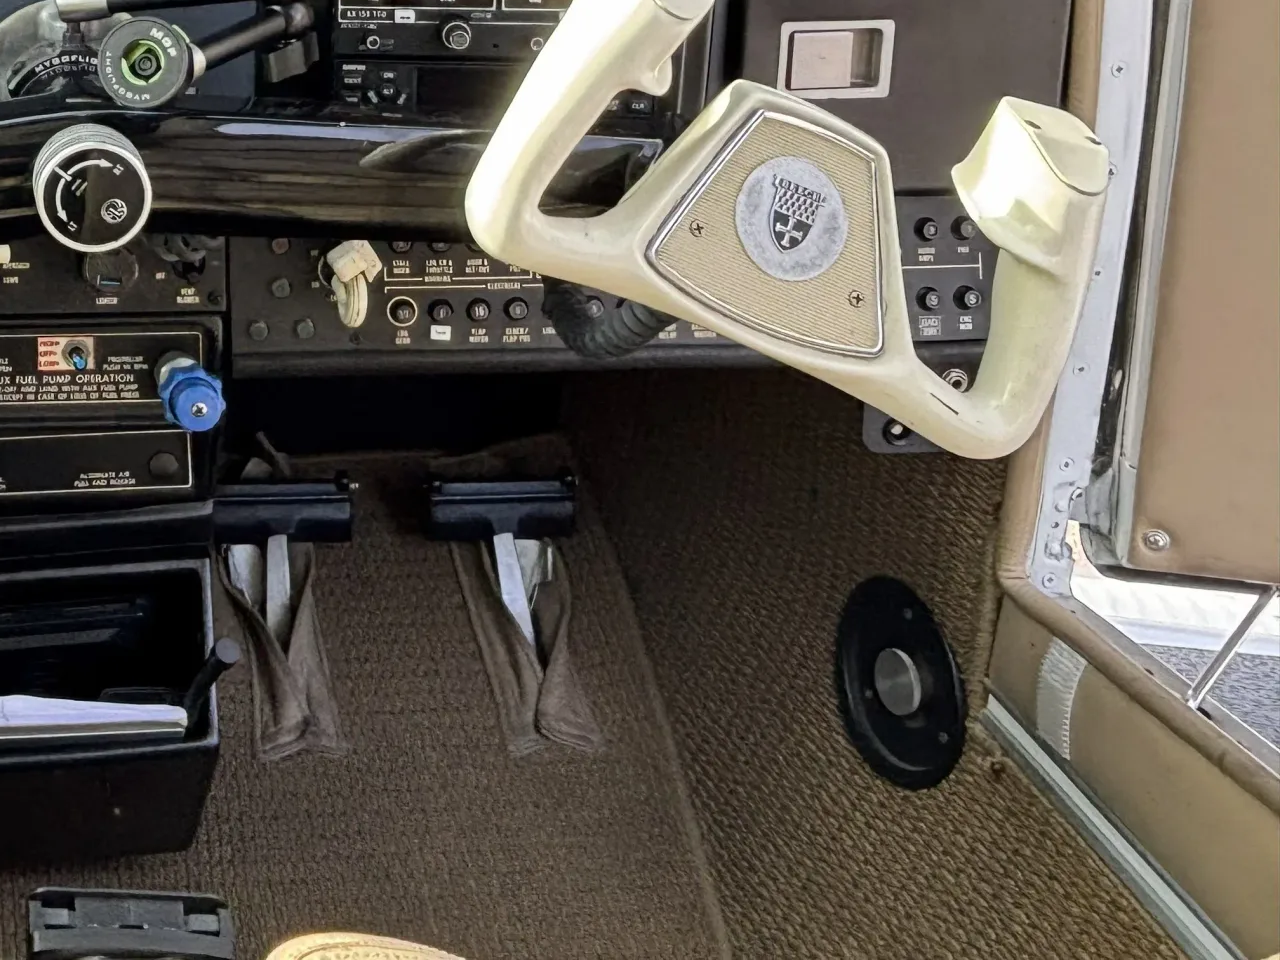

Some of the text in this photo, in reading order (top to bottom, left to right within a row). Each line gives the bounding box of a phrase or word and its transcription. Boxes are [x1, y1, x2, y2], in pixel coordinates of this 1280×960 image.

[15, 375, 38, 385] FUEL
[42, 375, 71, 385] PUMP
[75, 374, 135, 384] OPERATION
